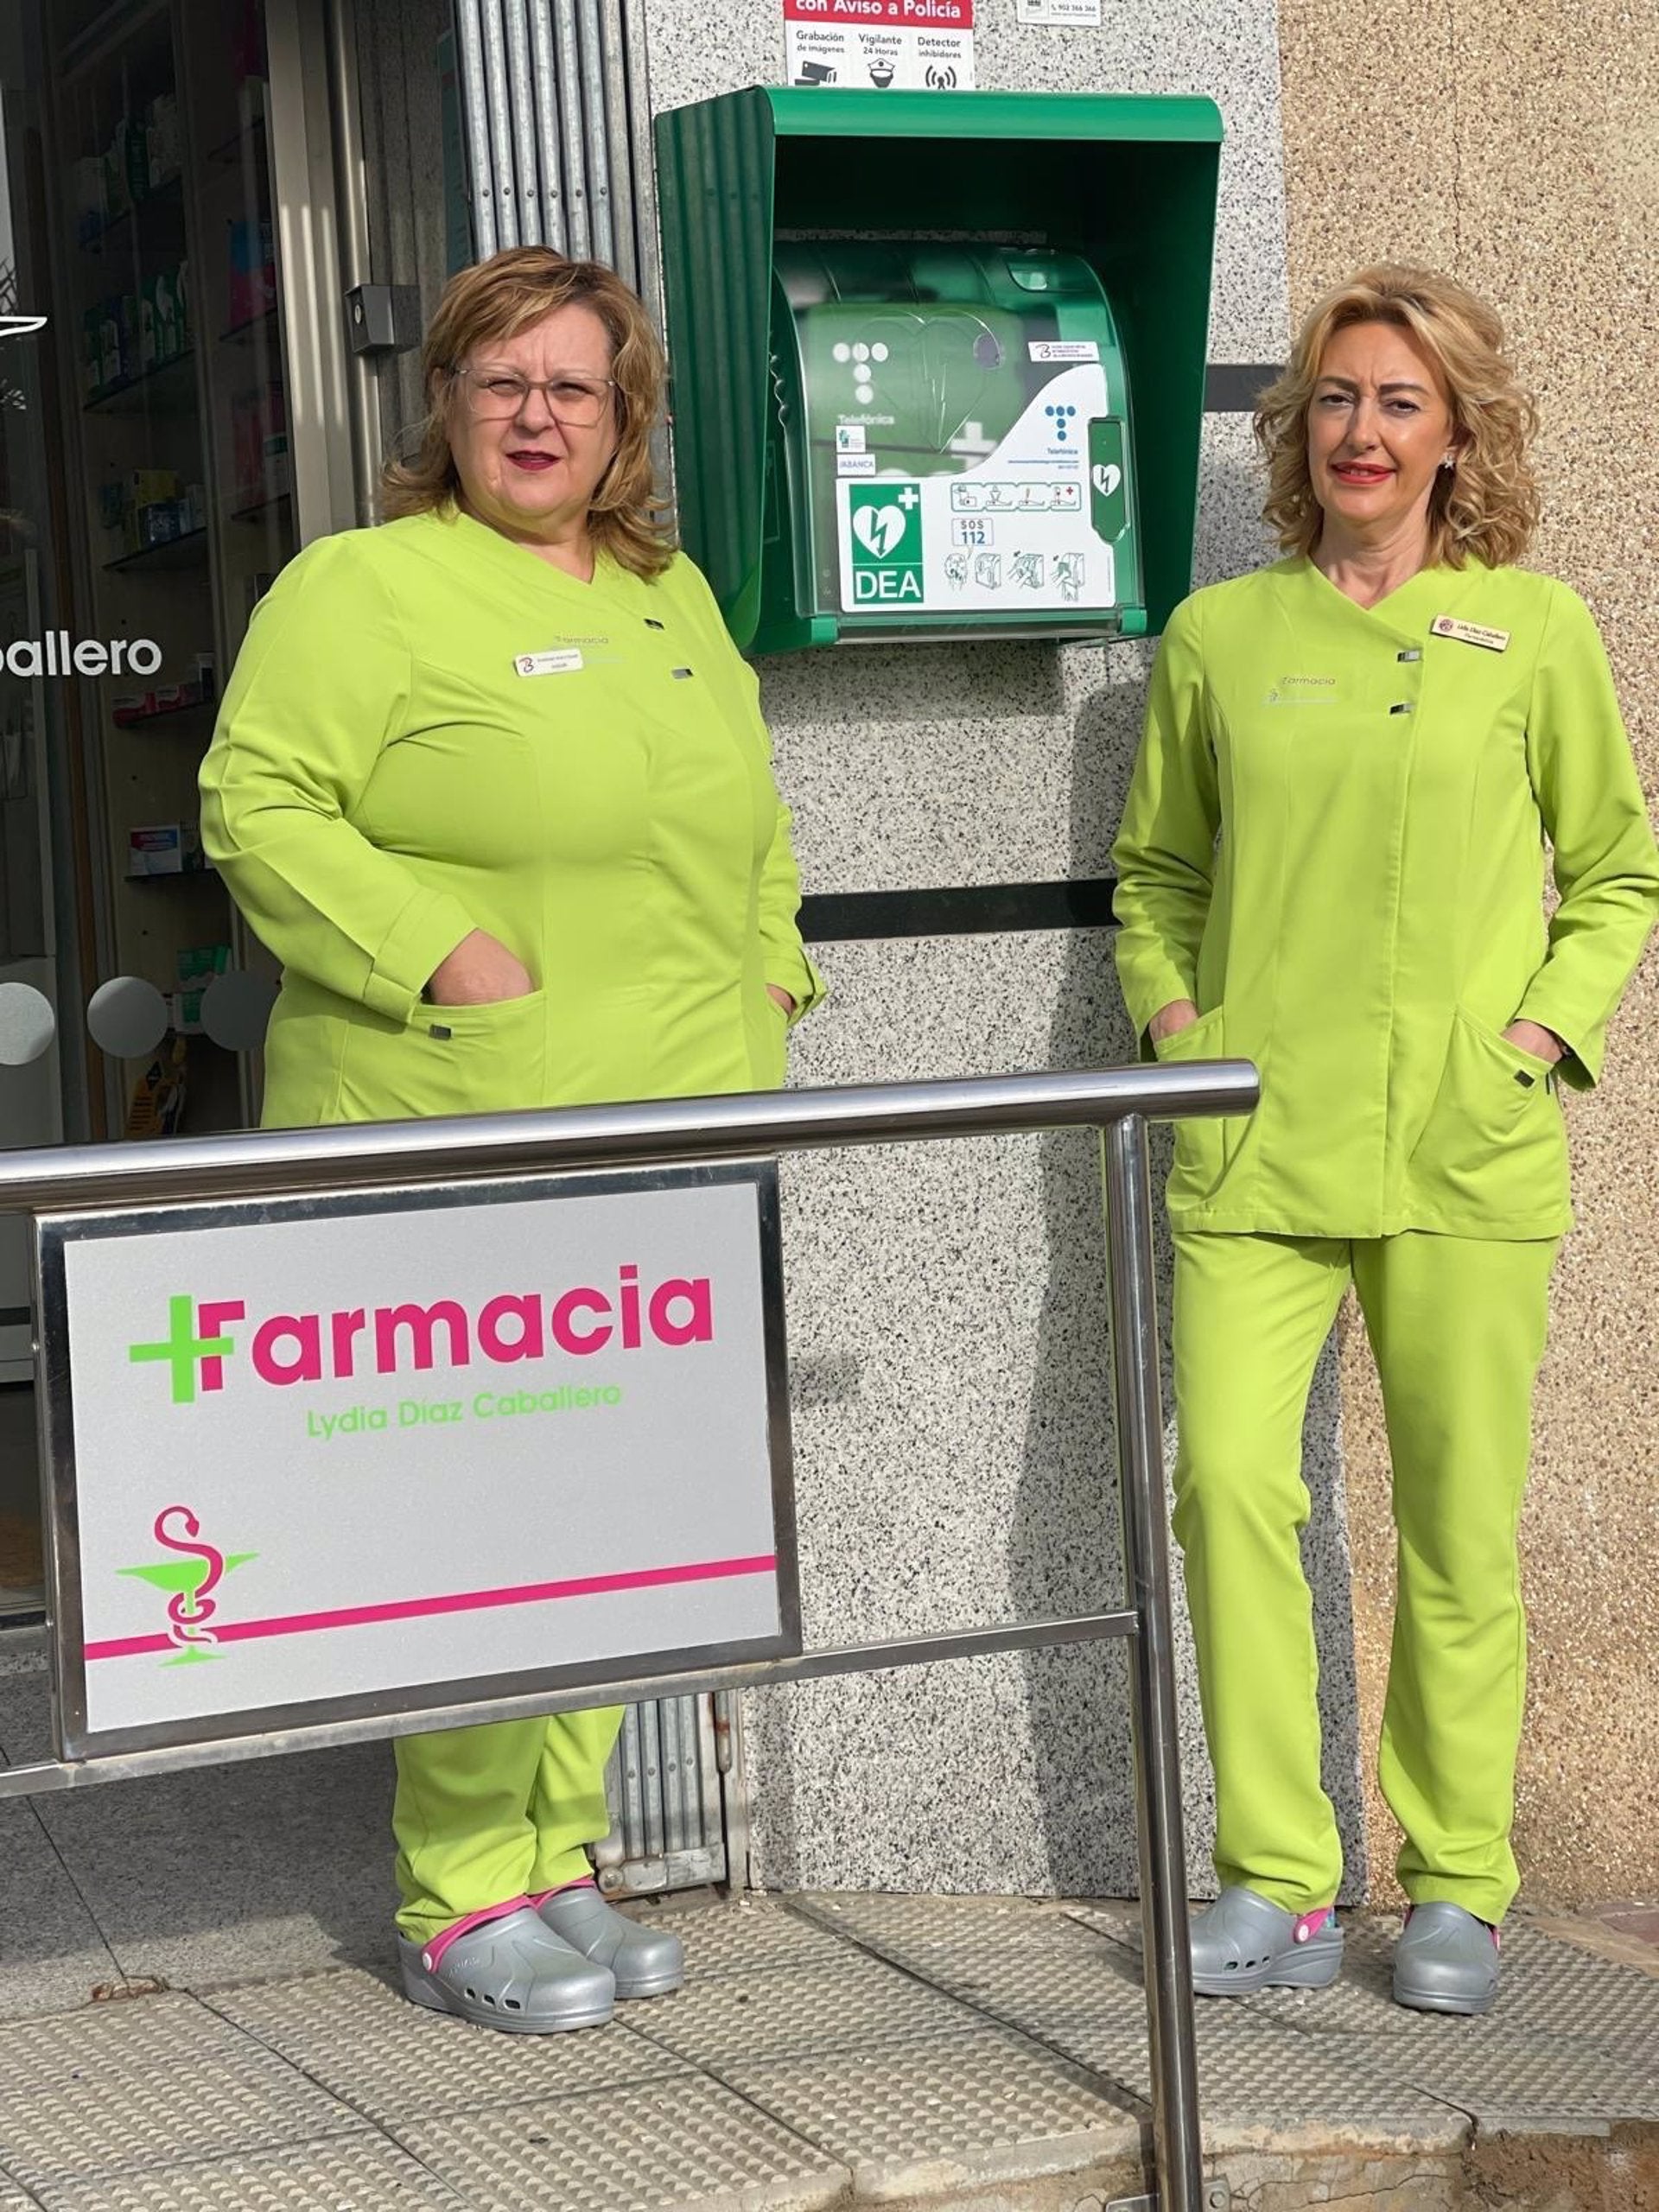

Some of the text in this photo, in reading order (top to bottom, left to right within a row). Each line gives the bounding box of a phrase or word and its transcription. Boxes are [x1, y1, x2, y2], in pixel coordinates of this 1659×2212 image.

[796, 0, 962, 18] con Aviso a Policía
[796, 30, 844, 41] Grabación
[858, 33, 902, 46] Vigilante
[917, 36, 962, 48] Detector
[874, 48, 898, 56] Horas
[918, 49, 962, 59] inhibidores
[960, 520, 984, 530] SOS
[962, 531, 985, 544] 112
[855, 570, 922, 599] DEA
[0, 630, 162, 677] allero
[197, 1264, 715, 1392] Farmacia
[307, 1405, 388, 1440] Lydia
[473, 1385, 622, 1419] Caballero
